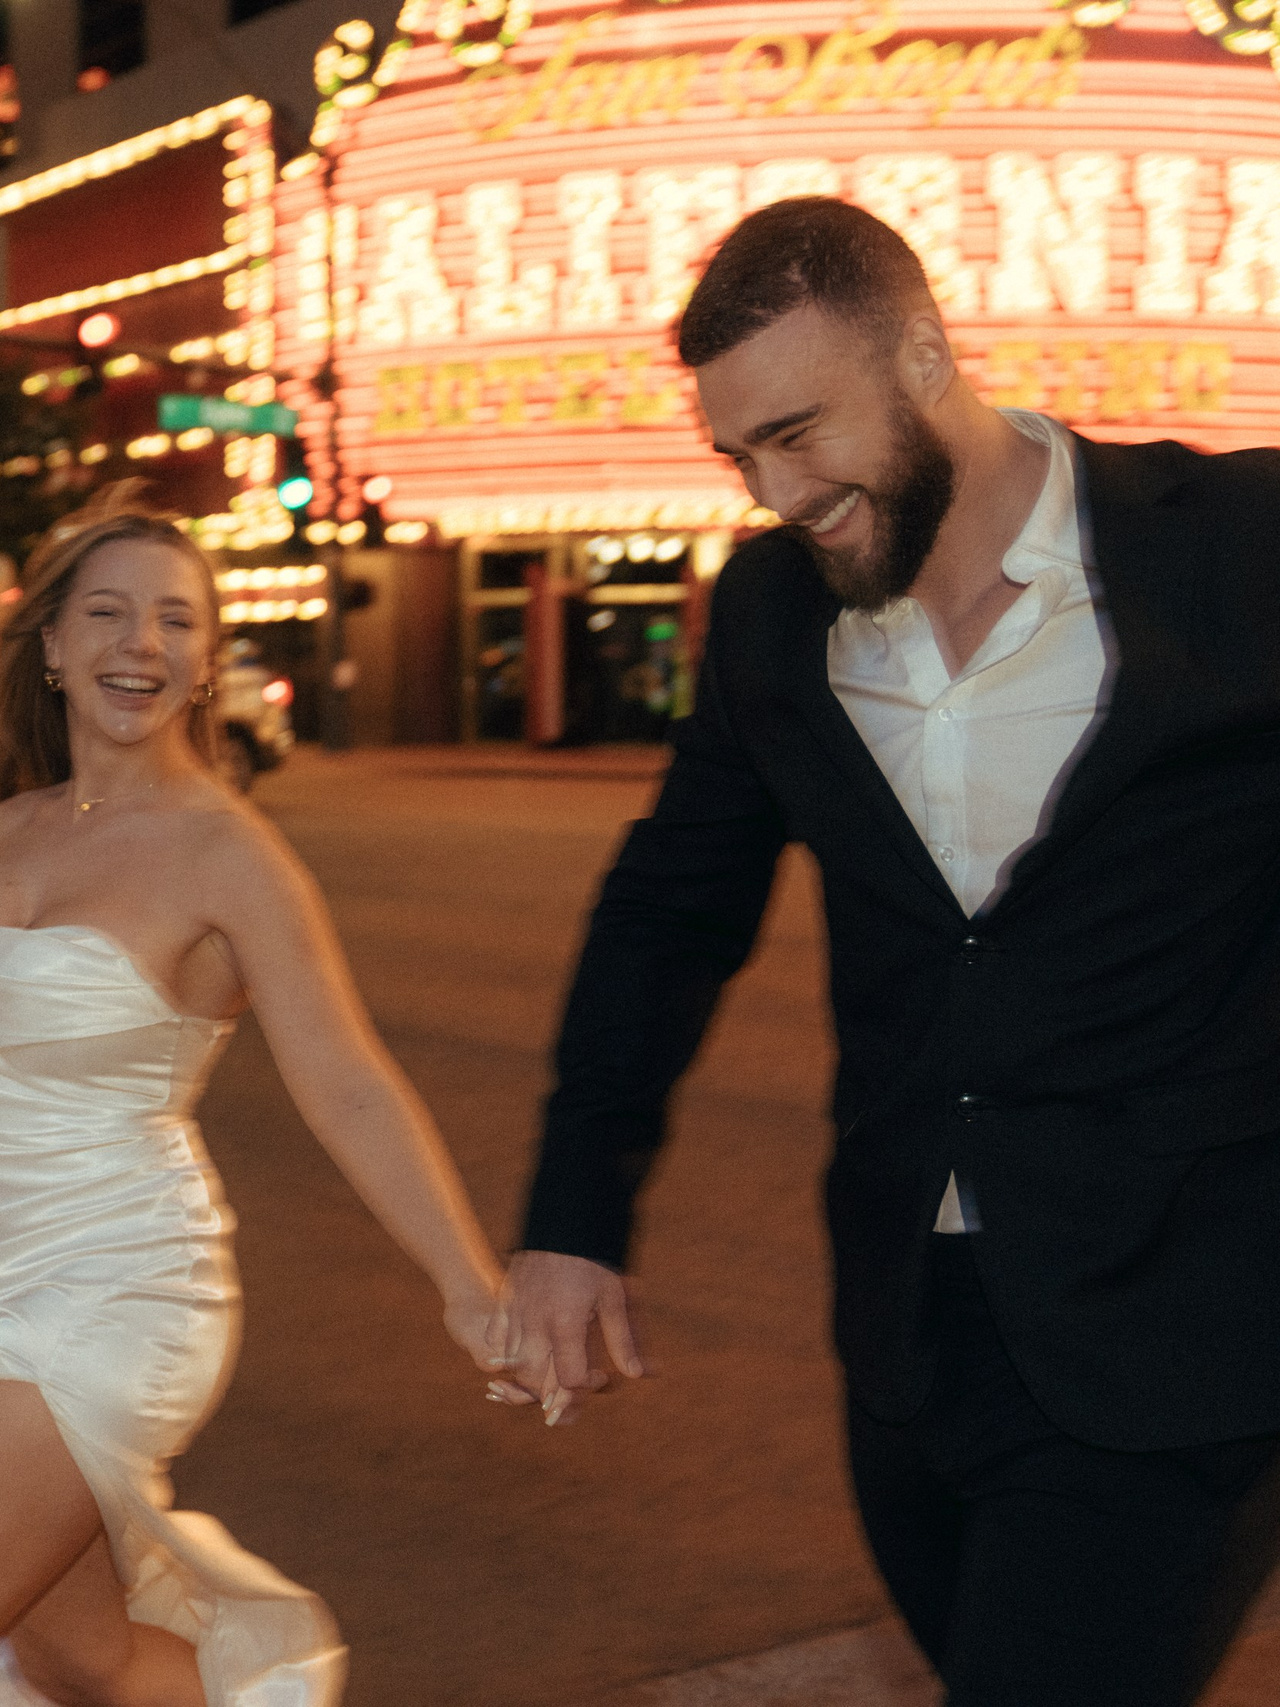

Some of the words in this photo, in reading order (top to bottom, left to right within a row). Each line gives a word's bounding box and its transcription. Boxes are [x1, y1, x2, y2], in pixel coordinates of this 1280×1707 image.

[291, 150, 1280, 350] CALIFRNIA
[373, 349, 682, 434] HOTEL
[956, 340, 1234, 420] SINO
